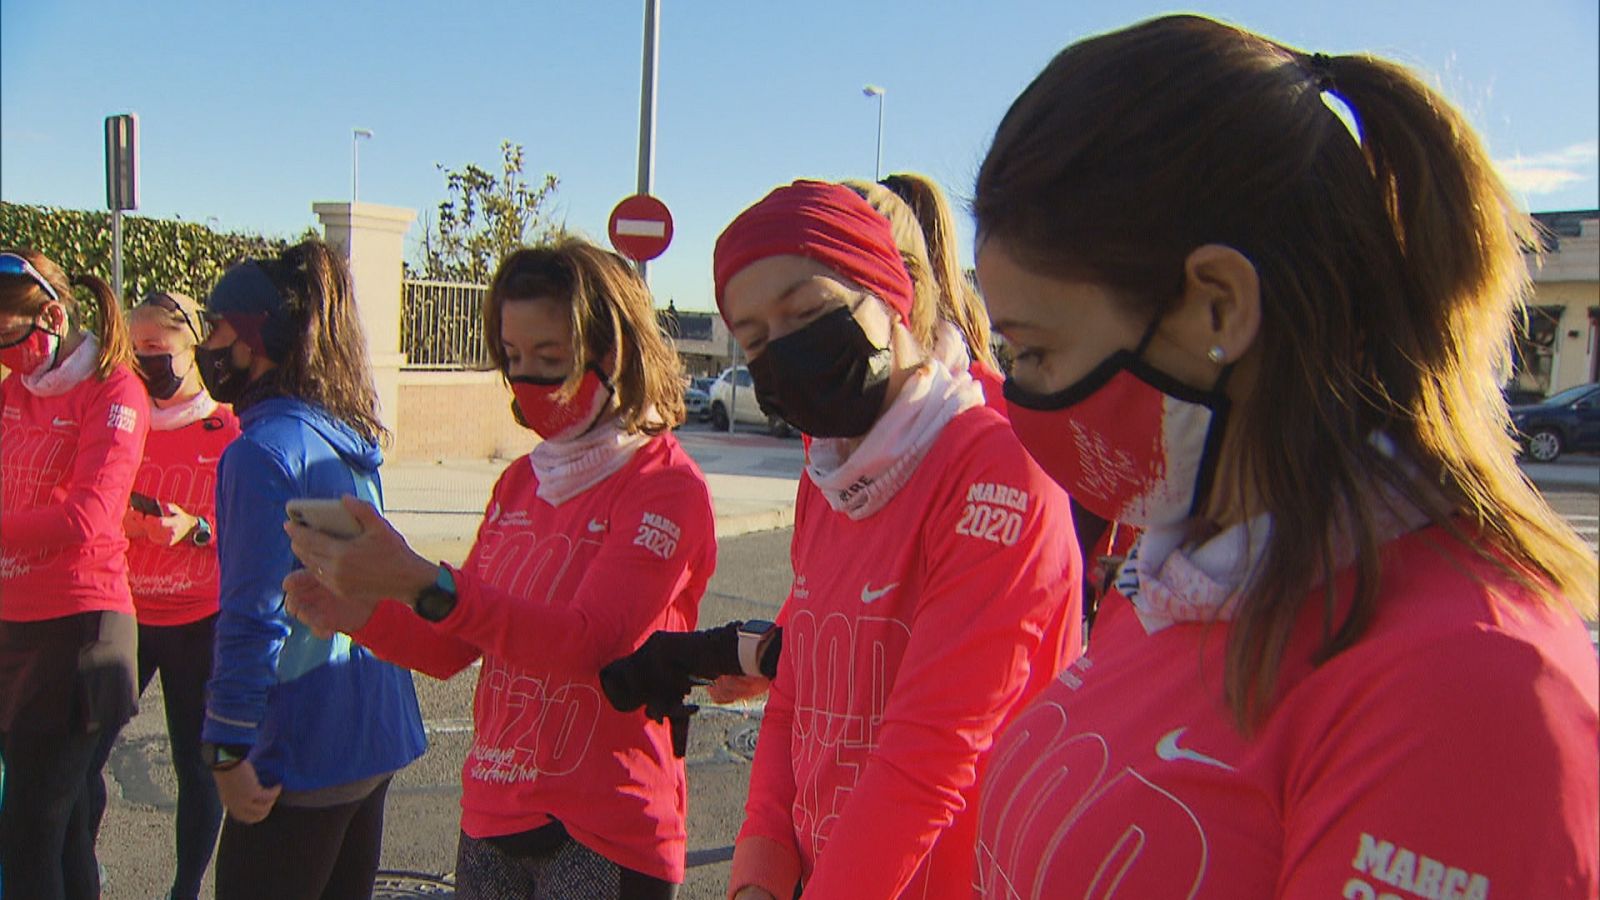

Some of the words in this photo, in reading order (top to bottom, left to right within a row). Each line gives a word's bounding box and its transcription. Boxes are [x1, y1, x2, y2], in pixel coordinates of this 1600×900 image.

[107, 413, 136, 433] 2020
[966, 482, 1028, 513] MARCA
[641, 511, 681, 542] MARCA
[956, 503, 1023, 547] 2020
[632, 524, 677, 560] 2020
[1352, 832, 1490, 900] MARCA
